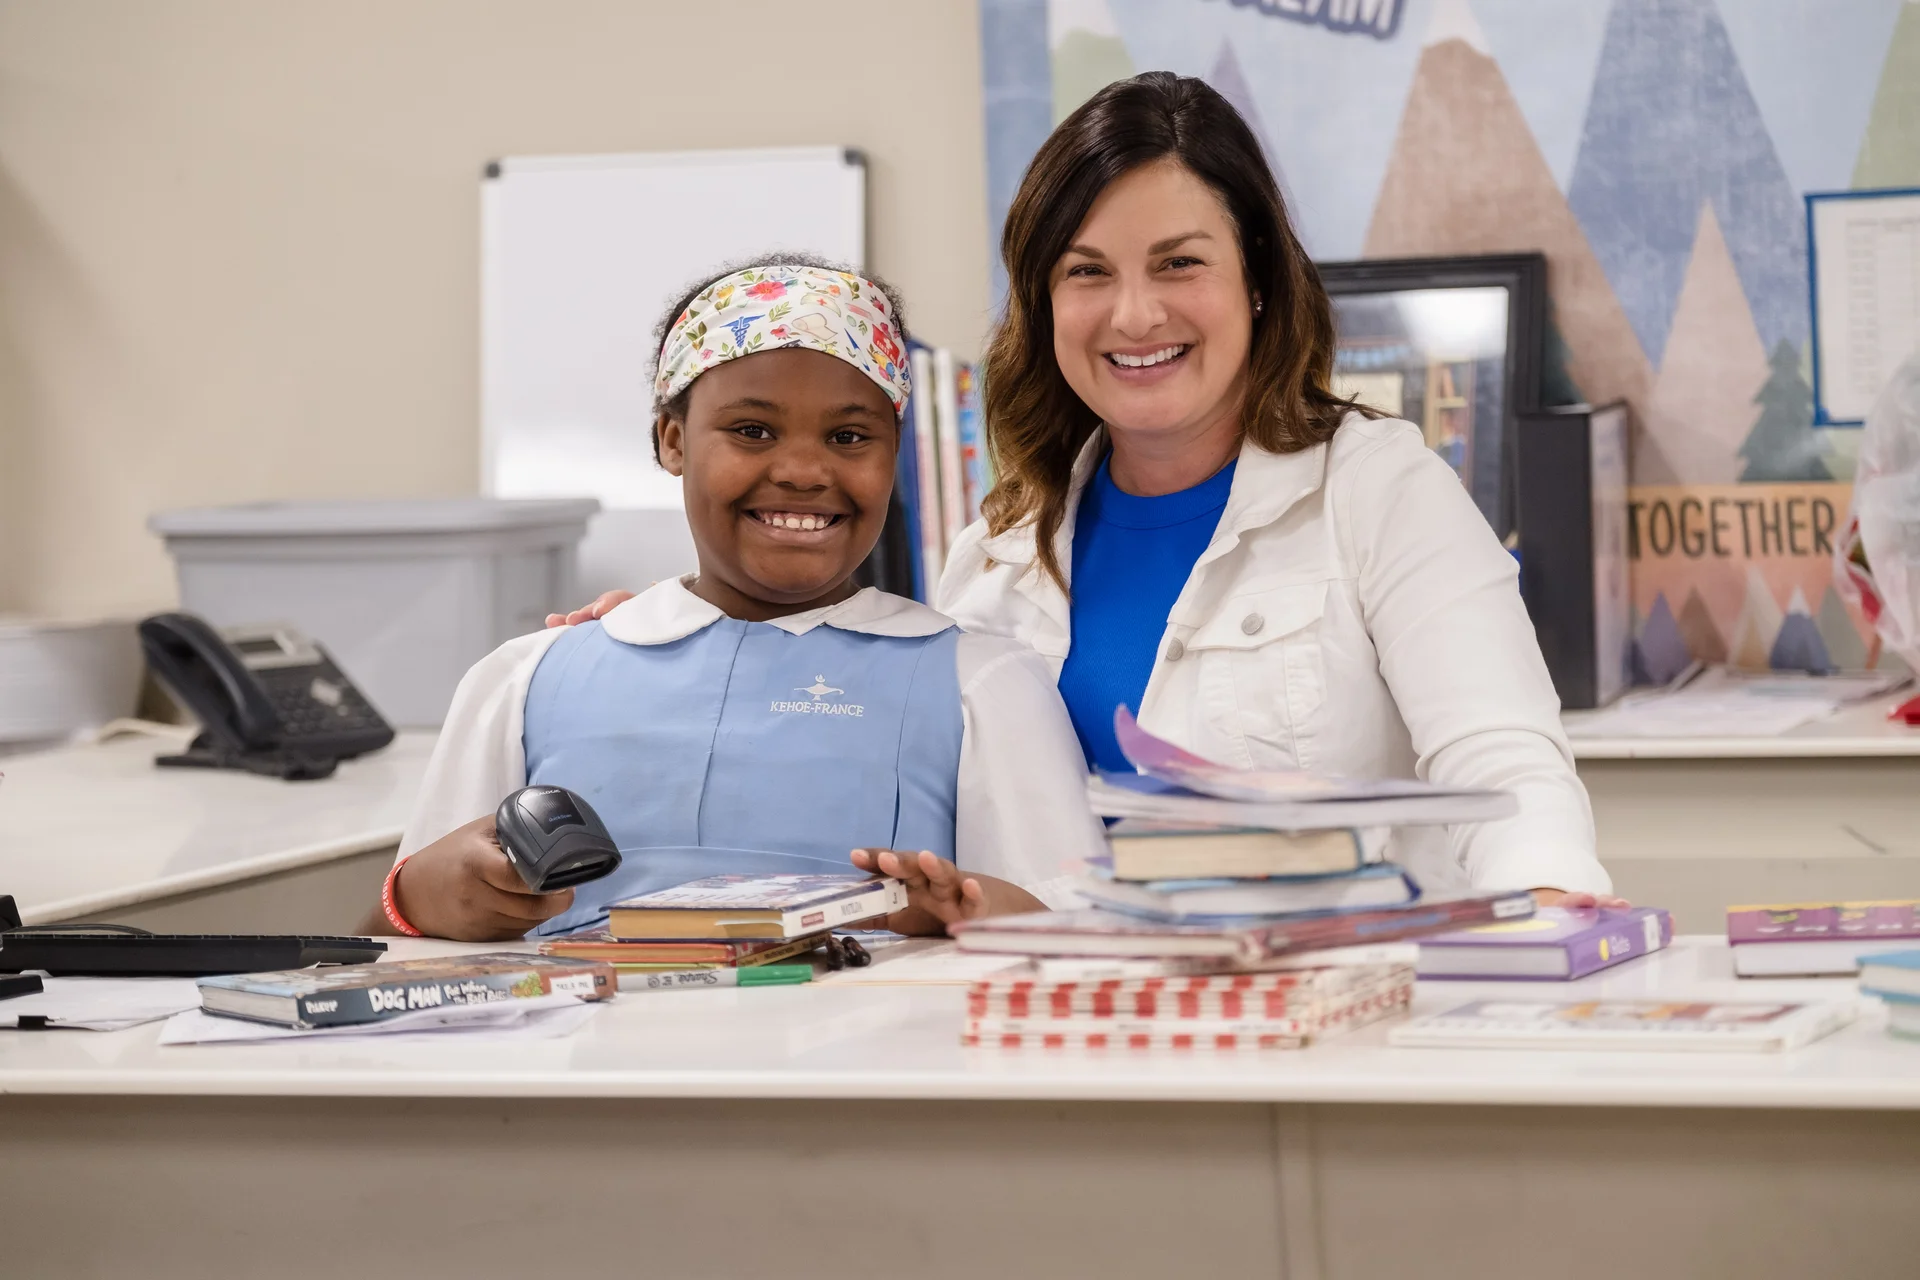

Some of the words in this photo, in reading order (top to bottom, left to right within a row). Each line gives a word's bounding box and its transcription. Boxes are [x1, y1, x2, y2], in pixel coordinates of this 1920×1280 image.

[1628, 496, 1835, 558] TOGETHER
[770, 700, 865, 717] KEHOE-FRANCE
[368, 986, 407, 1013] DOG
[408, 984, 443, 1010] MAN
